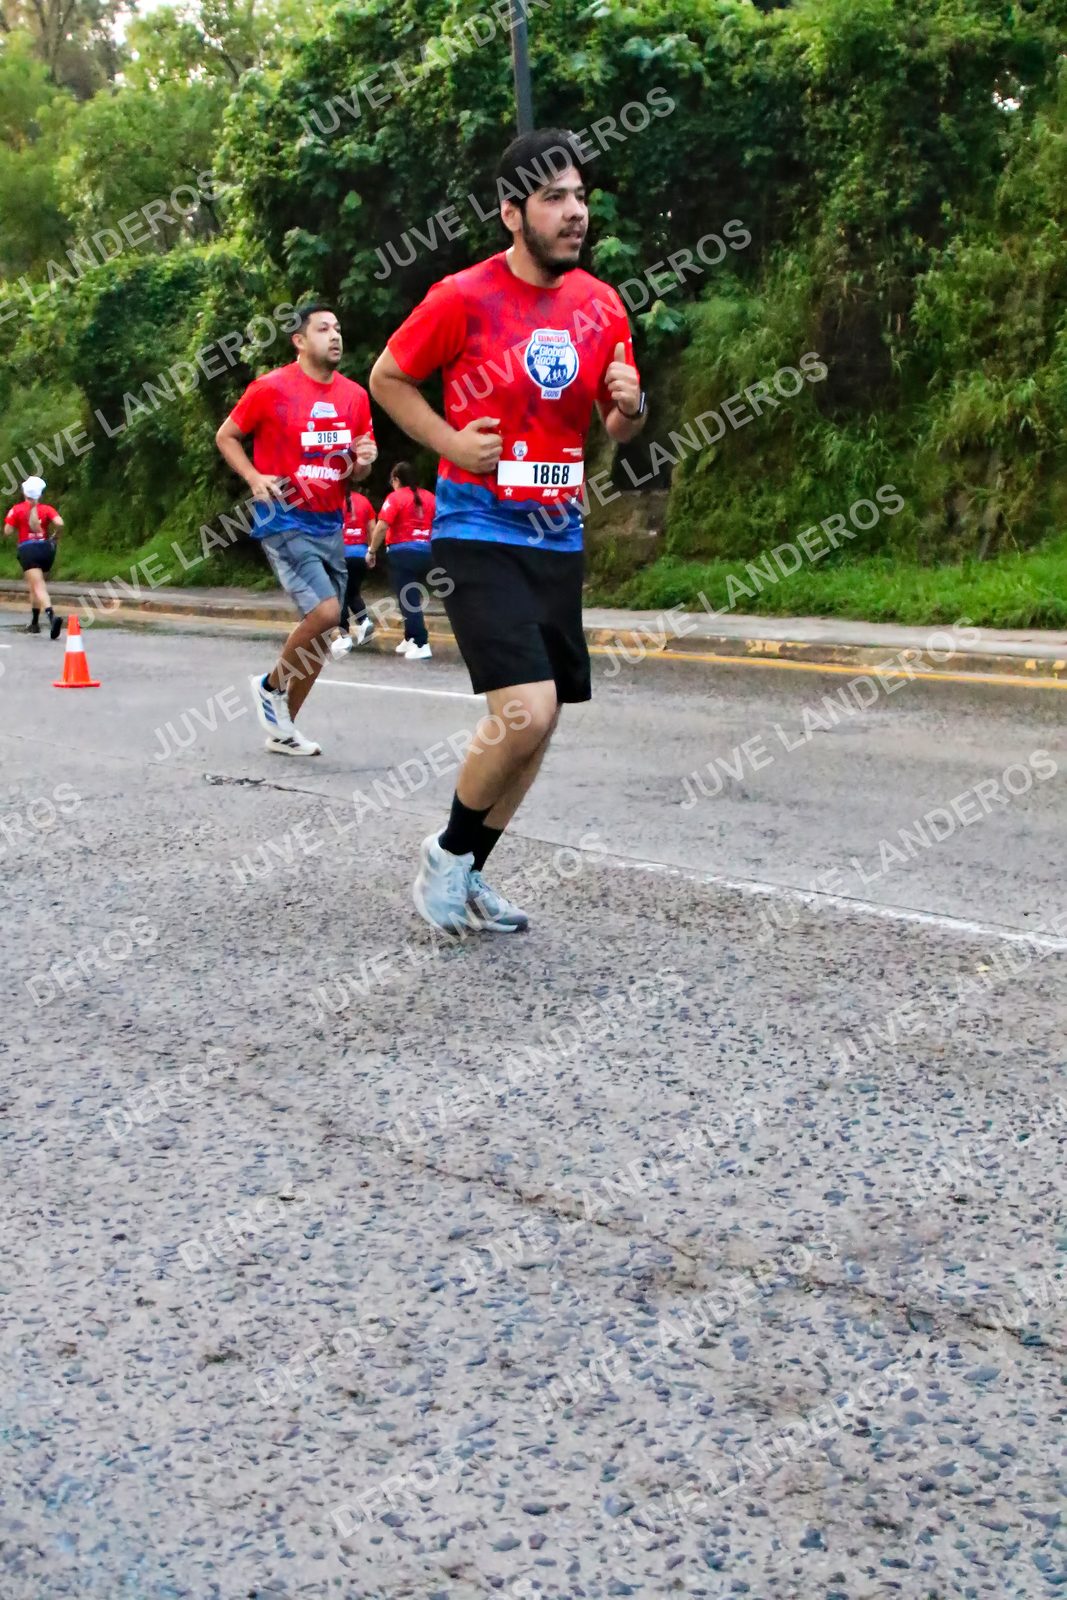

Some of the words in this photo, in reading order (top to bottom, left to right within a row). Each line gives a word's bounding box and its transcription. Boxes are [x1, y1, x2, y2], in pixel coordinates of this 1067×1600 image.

[539, 346, 565, 358] Global
[535, 356, 557, 367] Race
[317, 432, 338, 444] 3169
[532, 464, 570, 485] 1868
